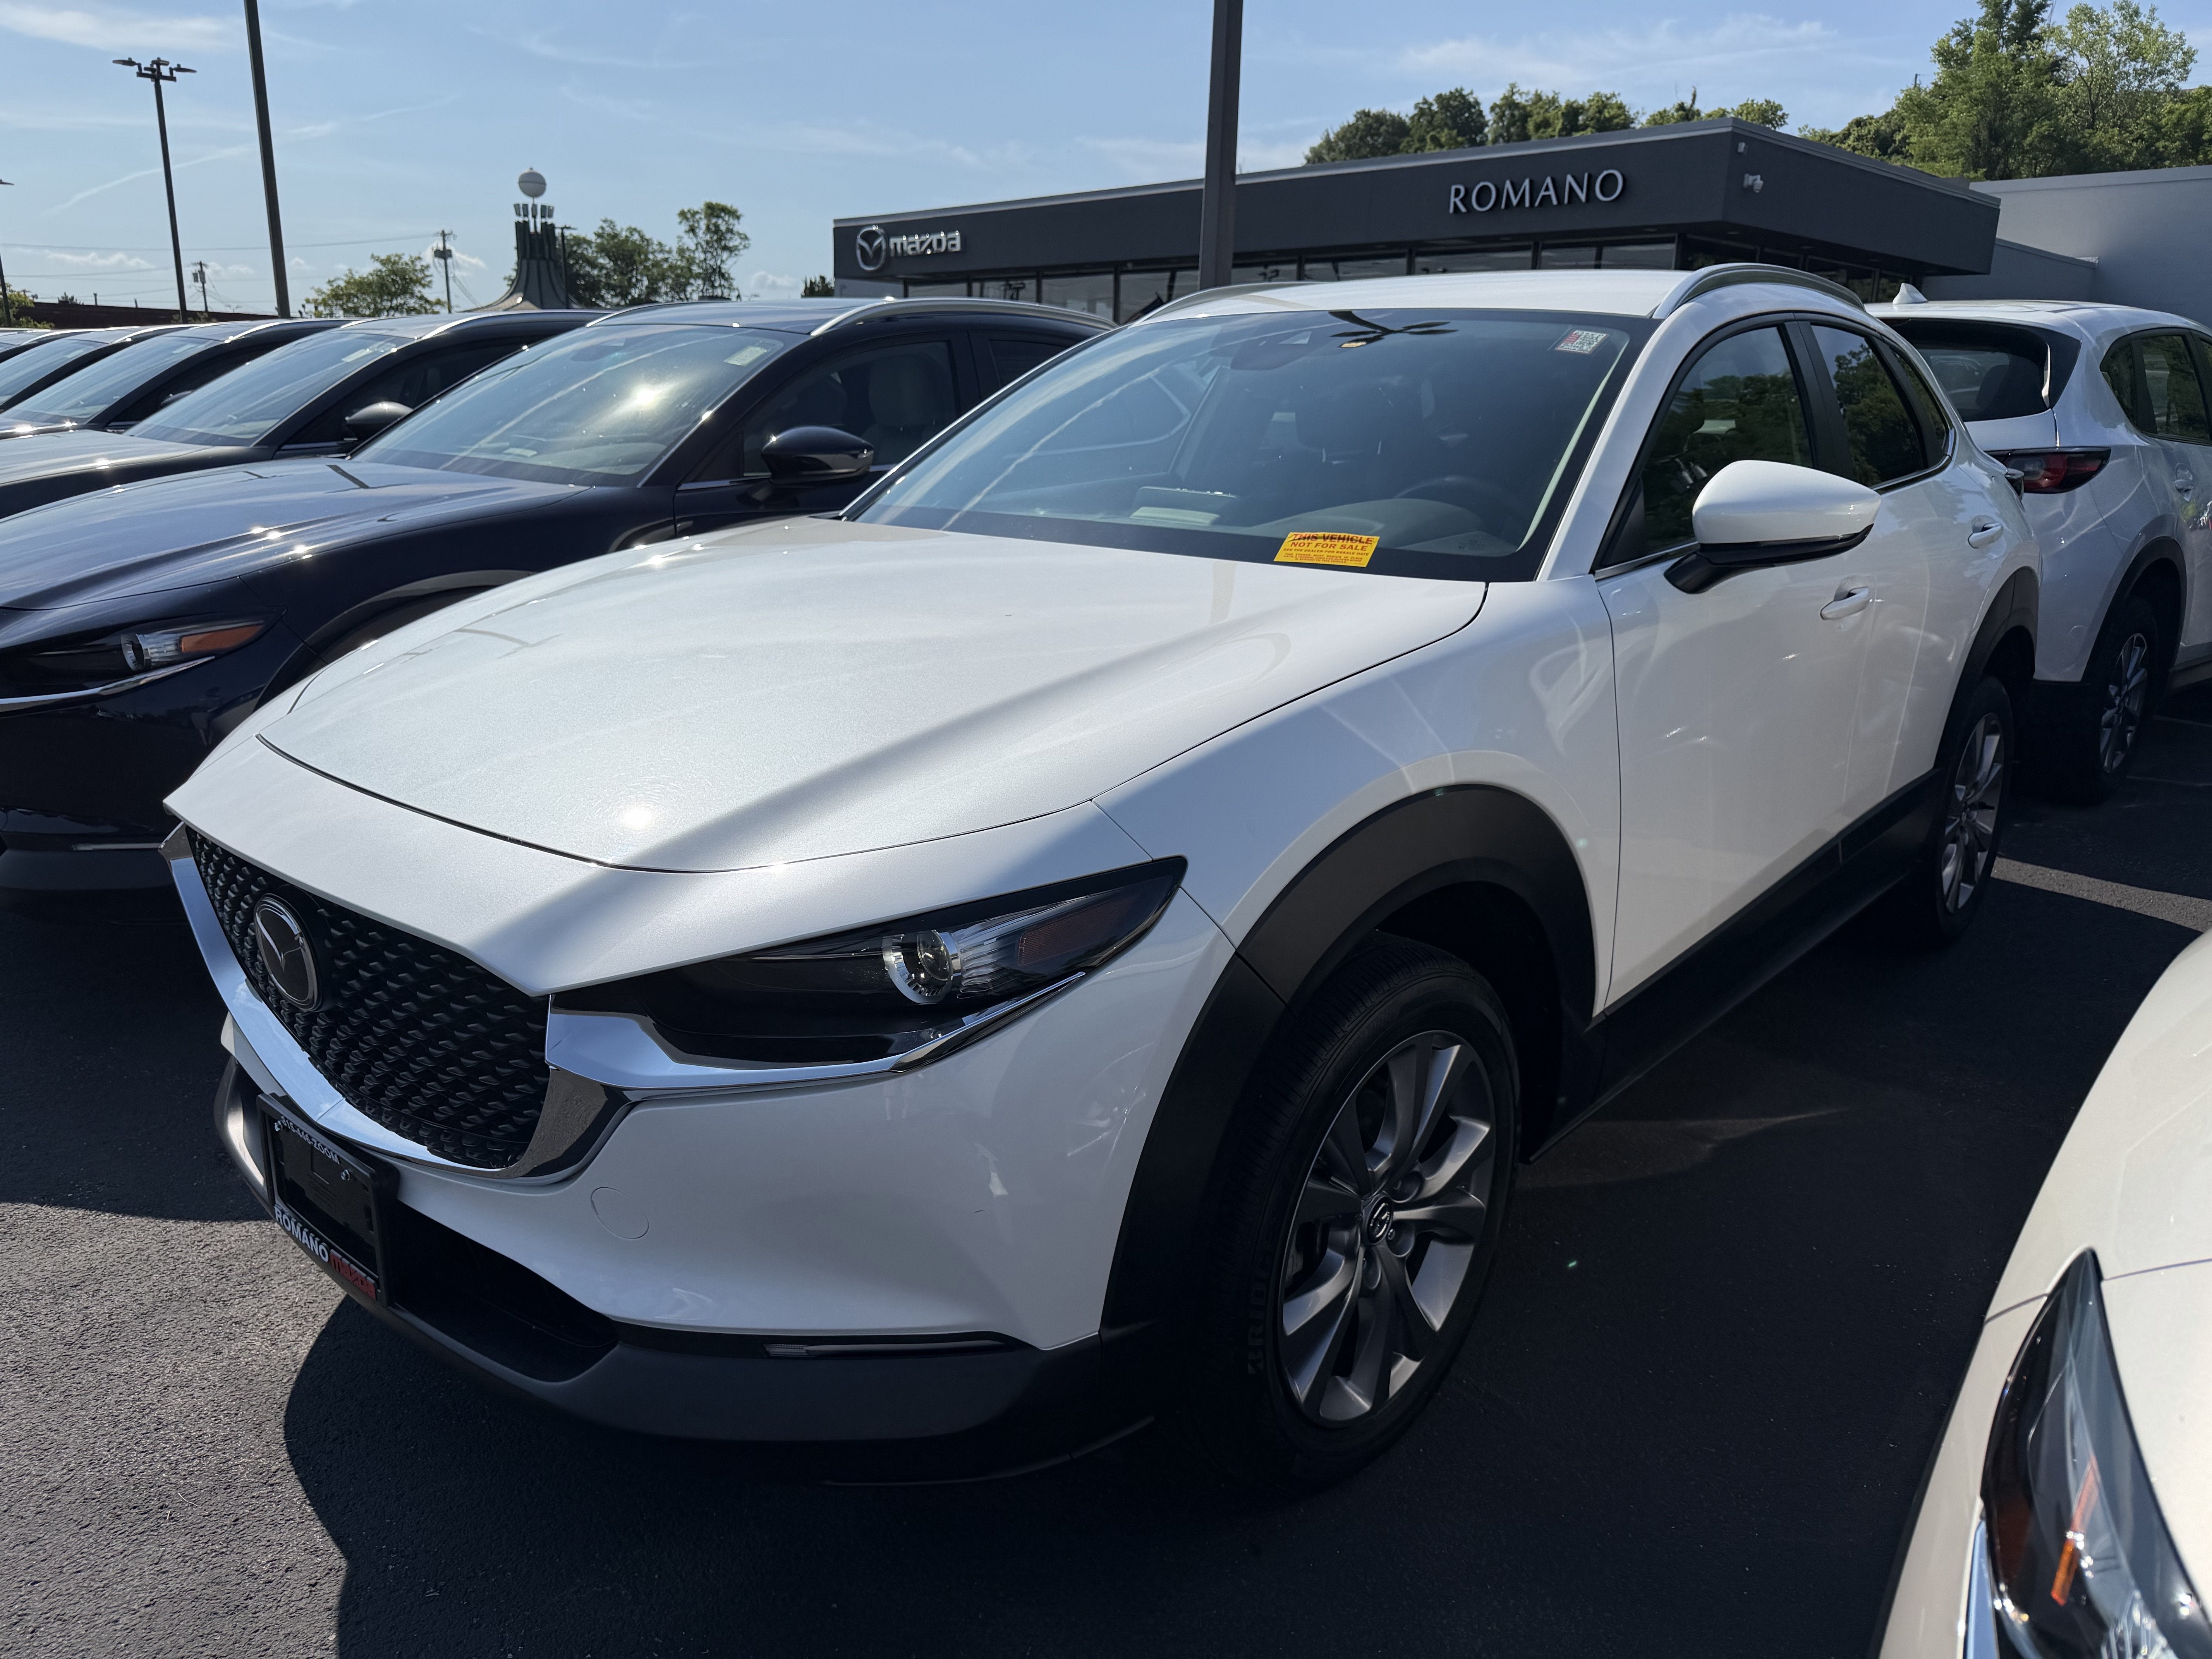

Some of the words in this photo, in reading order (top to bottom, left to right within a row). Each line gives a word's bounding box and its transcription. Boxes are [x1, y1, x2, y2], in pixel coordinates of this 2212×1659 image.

[1449, 169, 1623, 214] ROMANO
[889, 231, 961, 256] mazda
[1322, 534, 1374, 544] VEHICLE
[274, 1204, 329, 1262] ROMANO
